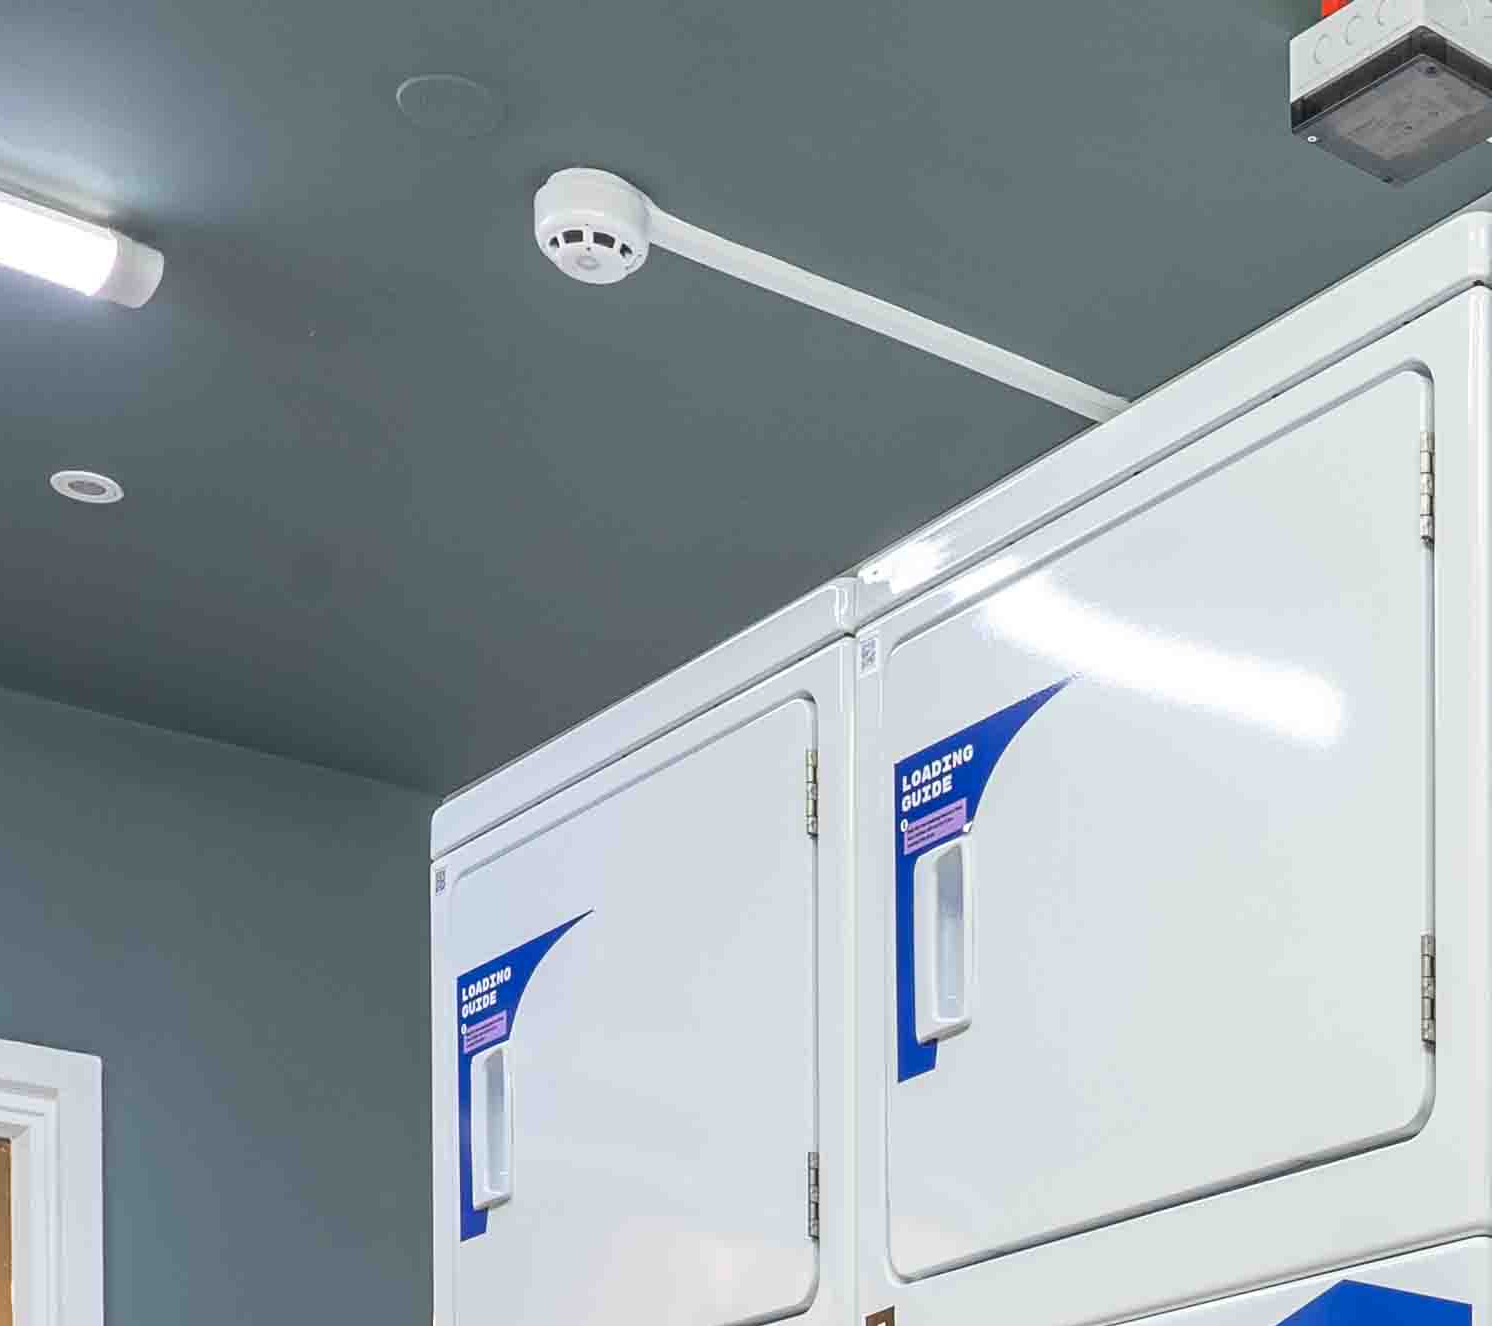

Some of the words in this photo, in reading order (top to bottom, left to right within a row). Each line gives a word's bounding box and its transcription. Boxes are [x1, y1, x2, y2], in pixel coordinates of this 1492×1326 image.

[902, 744, 974, 793] LOADING
[901, 773, 953, 812] GUIDE
[462, 966, 512, 1002] LOADING
[461, 990, 497, 1019] GUIDE
